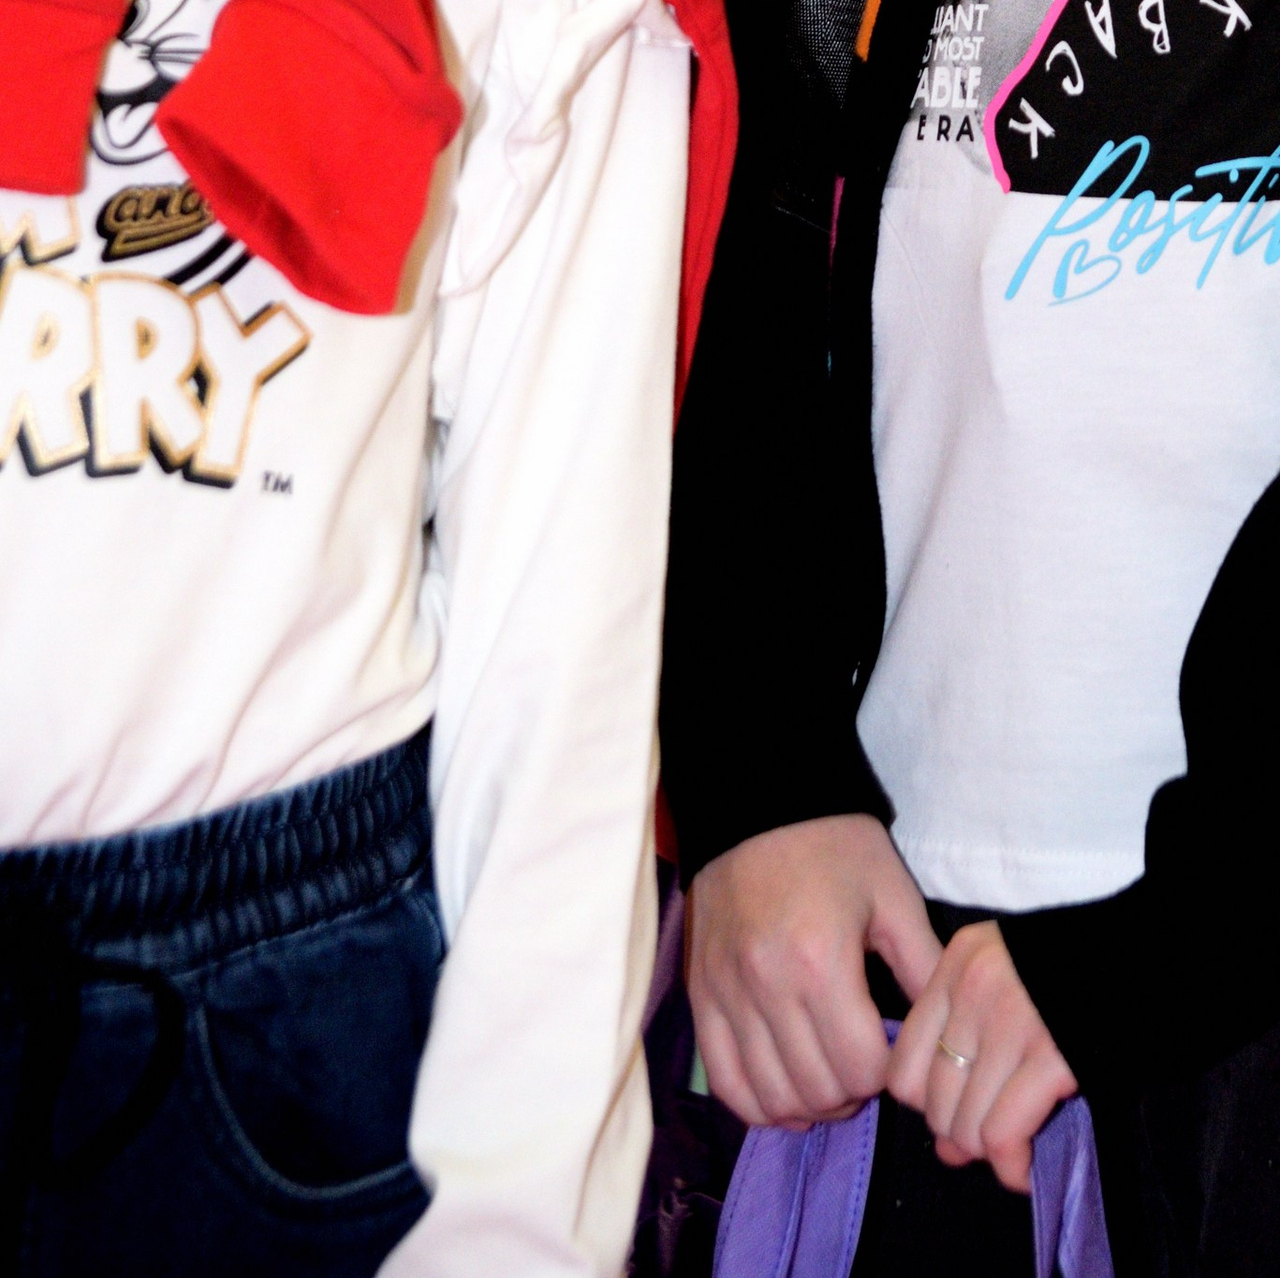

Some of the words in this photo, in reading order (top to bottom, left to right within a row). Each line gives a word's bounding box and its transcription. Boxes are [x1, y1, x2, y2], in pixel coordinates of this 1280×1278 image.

[930, 3, 989, 35] LIANT
[933, 36, 985, 61] MOST
[910, 66, 983, 109] ABLE
[0, 265, 314, 489] RRY
